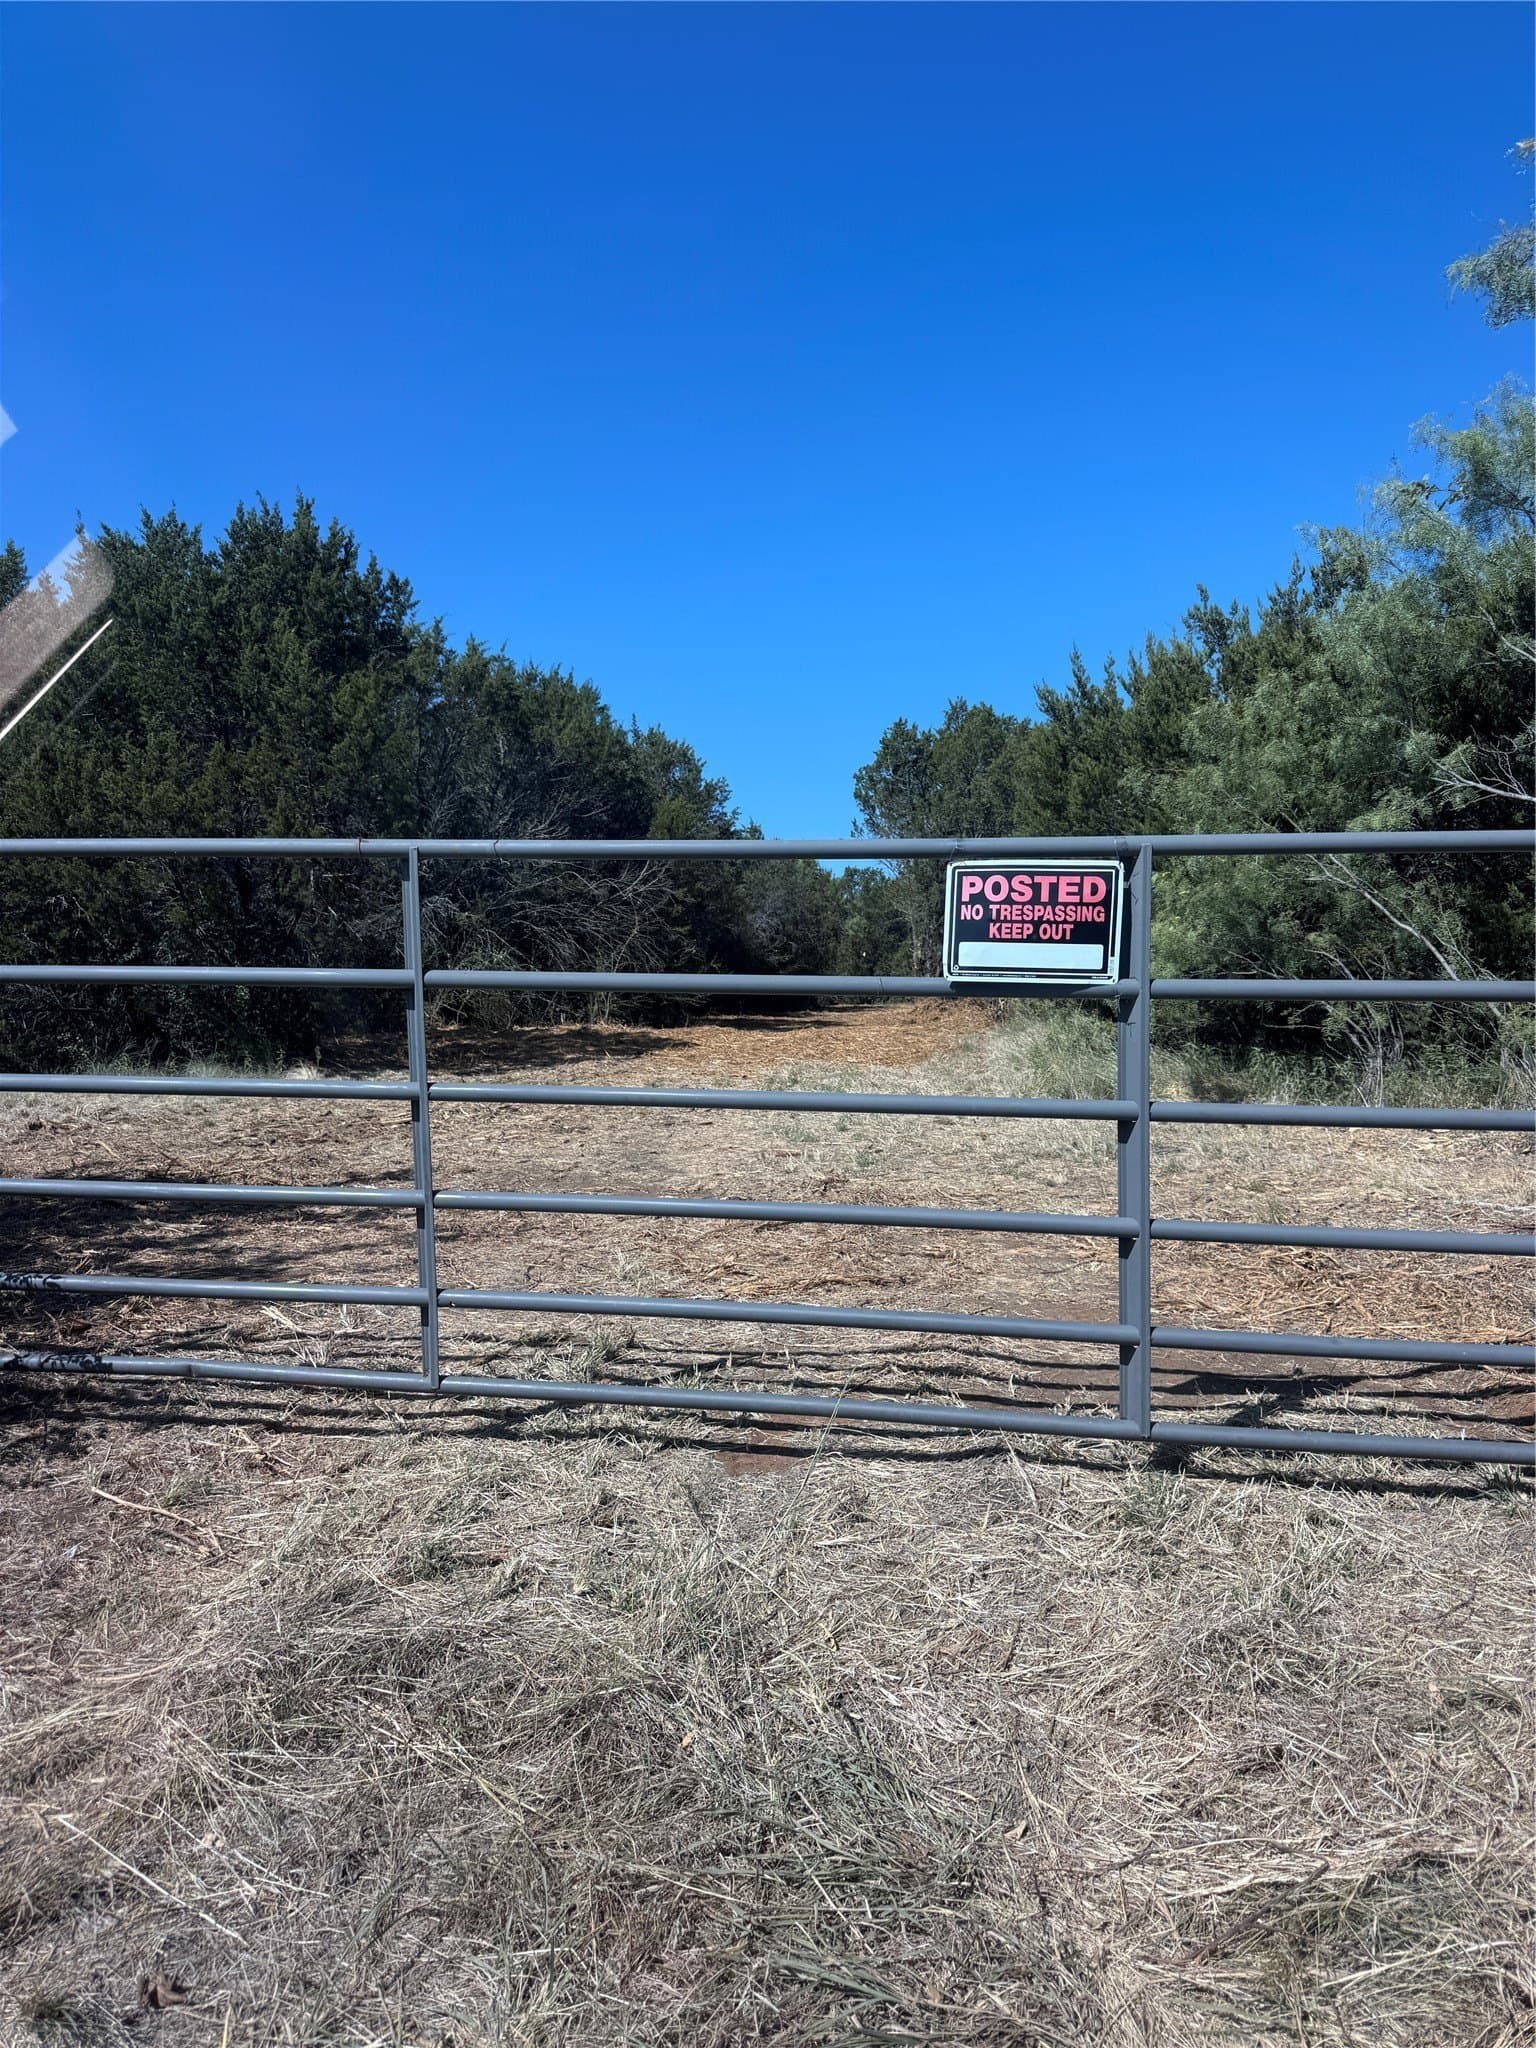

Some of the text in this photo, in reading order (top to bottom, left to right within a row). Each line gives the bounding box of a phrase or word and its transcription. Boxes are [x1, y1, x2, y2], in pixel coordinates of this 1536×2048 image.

[961, 874, 1107, 903] POSTED
[960, 904, 1106, 923] NO TRESPASSING
[988, 923, 1074, 940] KEEP OUT
